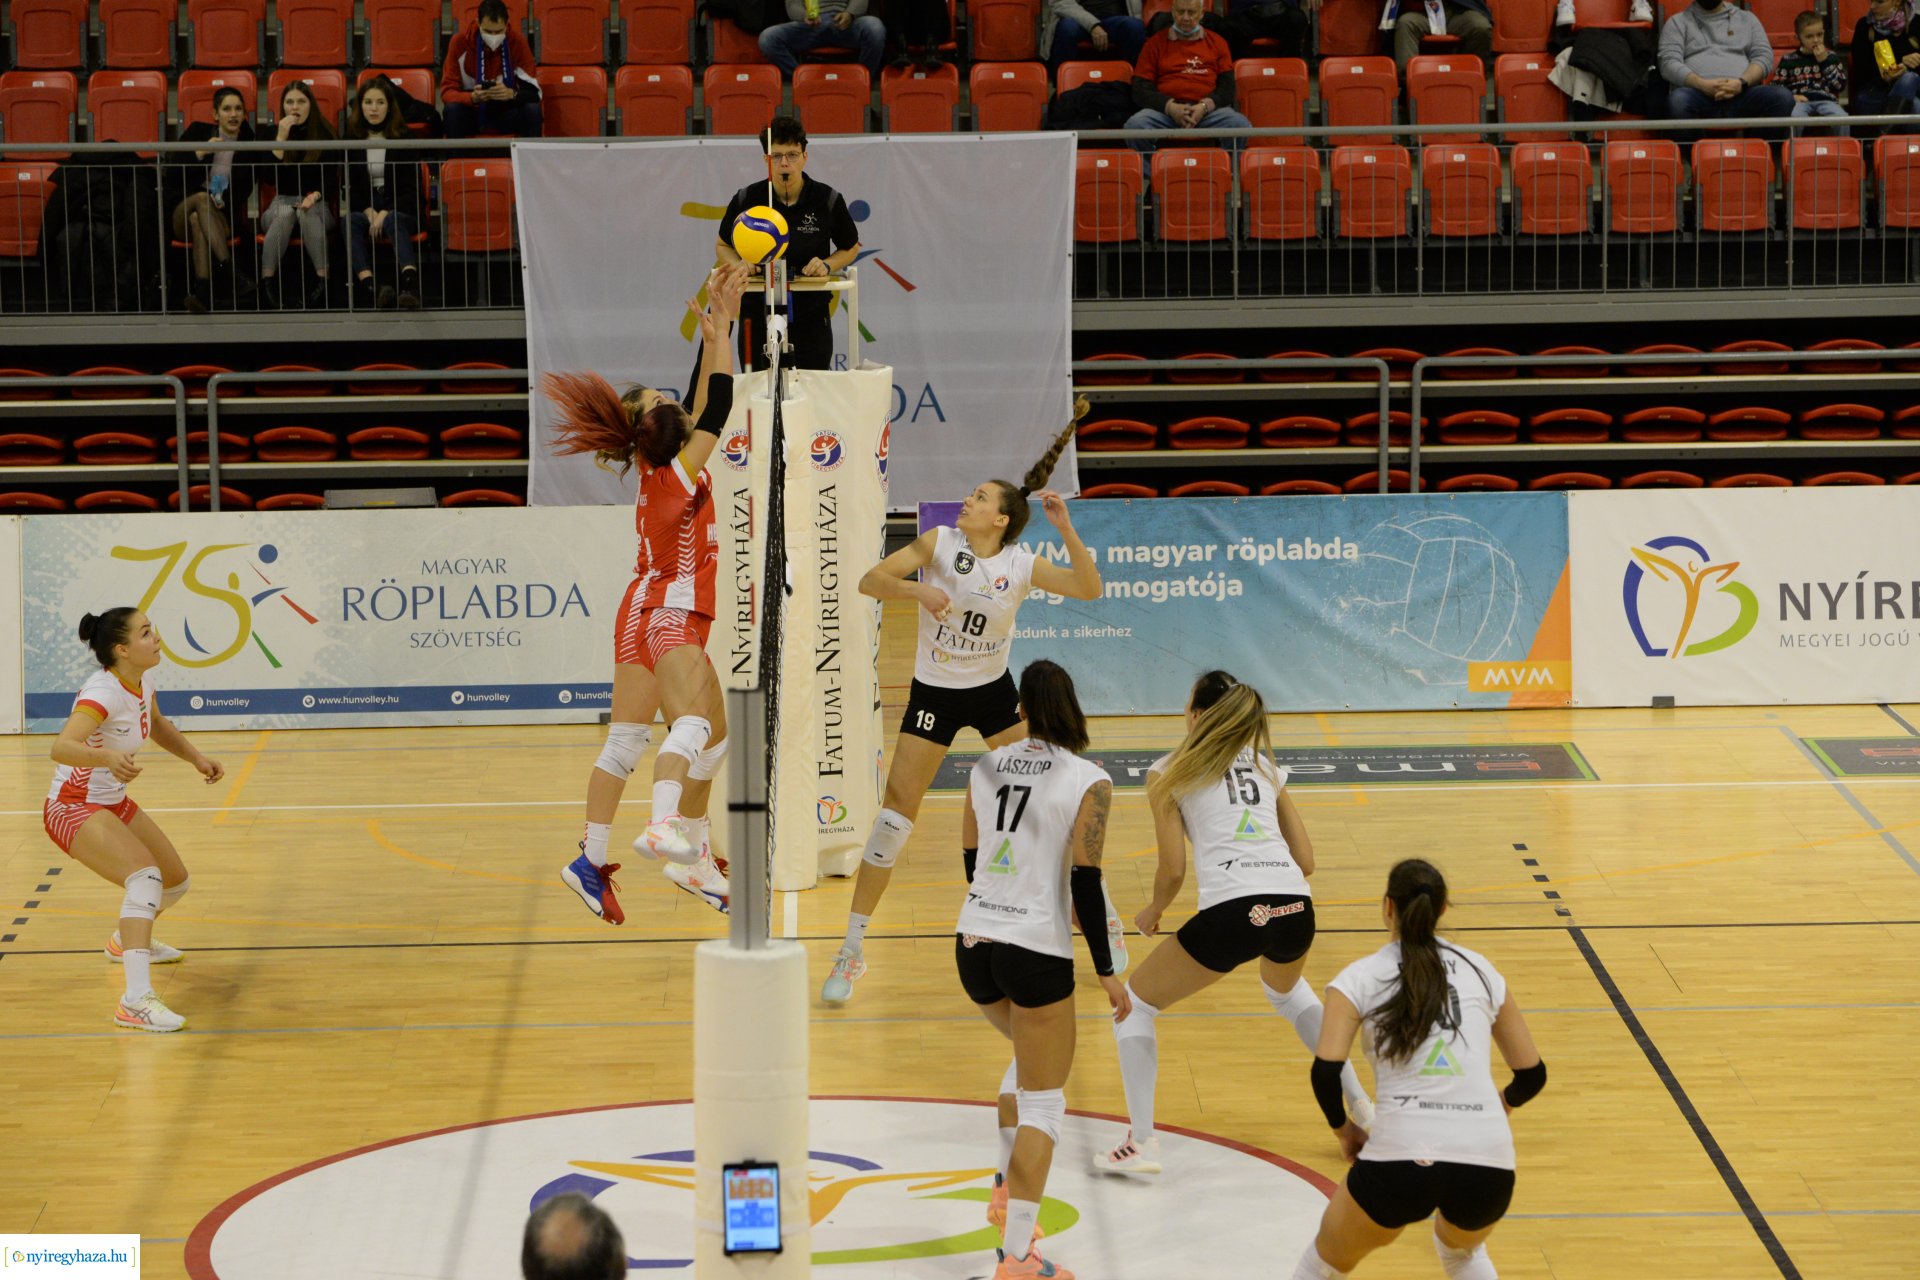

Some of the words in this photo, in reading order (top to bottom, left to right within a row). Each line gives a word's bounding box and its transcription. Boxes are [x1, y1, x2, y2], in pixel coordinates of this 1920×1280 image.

[1107, 544, 1217, 568] magyar
[1227, 536, 1359, 566] röplabda
[421, 558, 507, 575] MAGYAR
[343, 578, 591, 622] RÖPLABDA
[961, 610, 988, 637] 19
[1061, 630, 1070, 638] a
[1073, 625, 1132, 638] sikerhez
[410, 627, 521, 649] SZÖVETSÉG
[1780, 634, 1850, 648] MEGYEI
[1858, 629, 1910, 647] JOGÚ
[1483, 667, 1554, 686] MVM
[206, 698, 250, 708] hunvolley
[318, 695, 400, 706] www.hunvolley.hu
[467, 693, 511, 703] hunvolley
[575, 691, 613, 701] hunvolle
[140, 711, 149, 740] 6
[916, 709, 936, 731] 19
[1223, 767, 1261, 806] 15
[995, 784, 1032, 833] 17
[978, 900, 1028, 915] BESTRONG
[1419, 1101, 1484, 1112] BESTRONG
